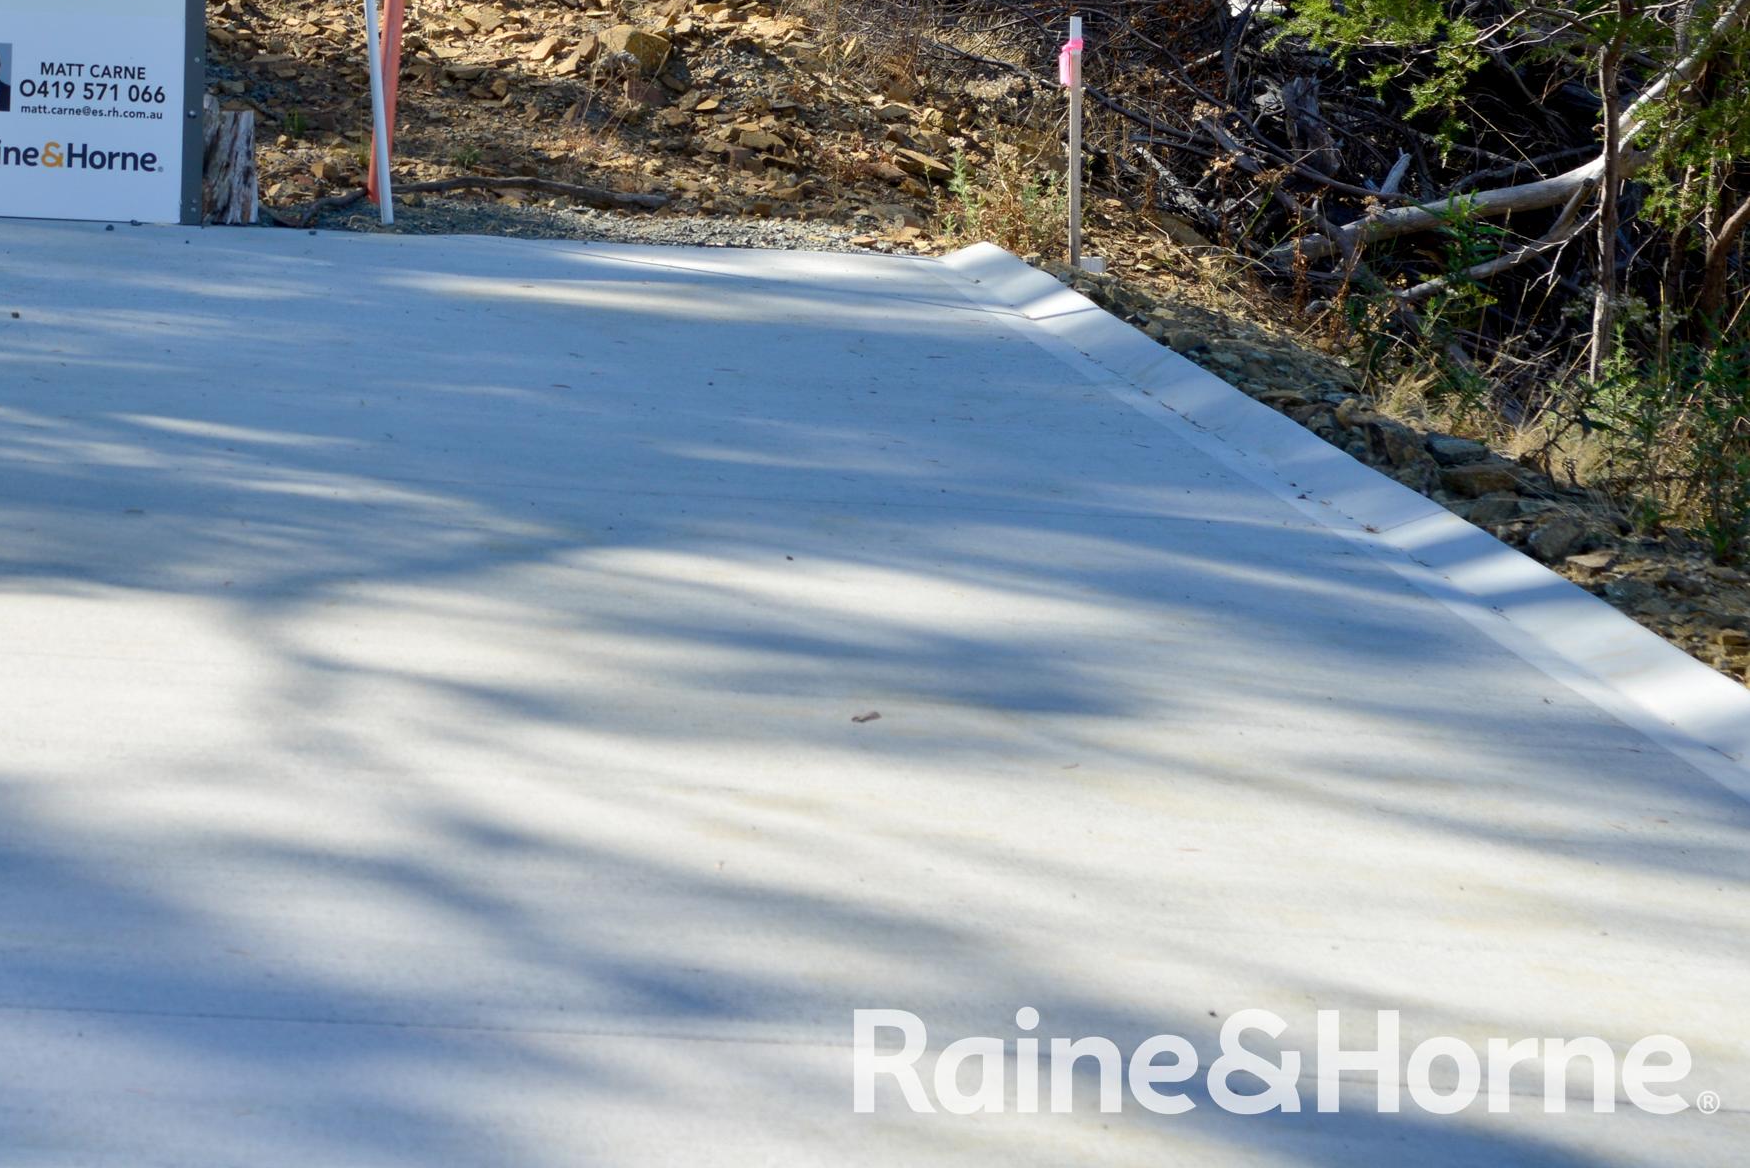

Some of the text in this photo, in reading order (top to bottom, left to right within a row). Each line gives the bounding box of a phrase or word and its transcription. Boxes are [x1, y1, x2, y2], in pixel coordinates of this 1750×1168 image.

[40, 62, 146, 80] MATT CARNE
[83, 82, 119, 102] 571
[128, 84, 166, 104] 066
[20, 104, 163, 120] matt.carne@es.rh.com.au
